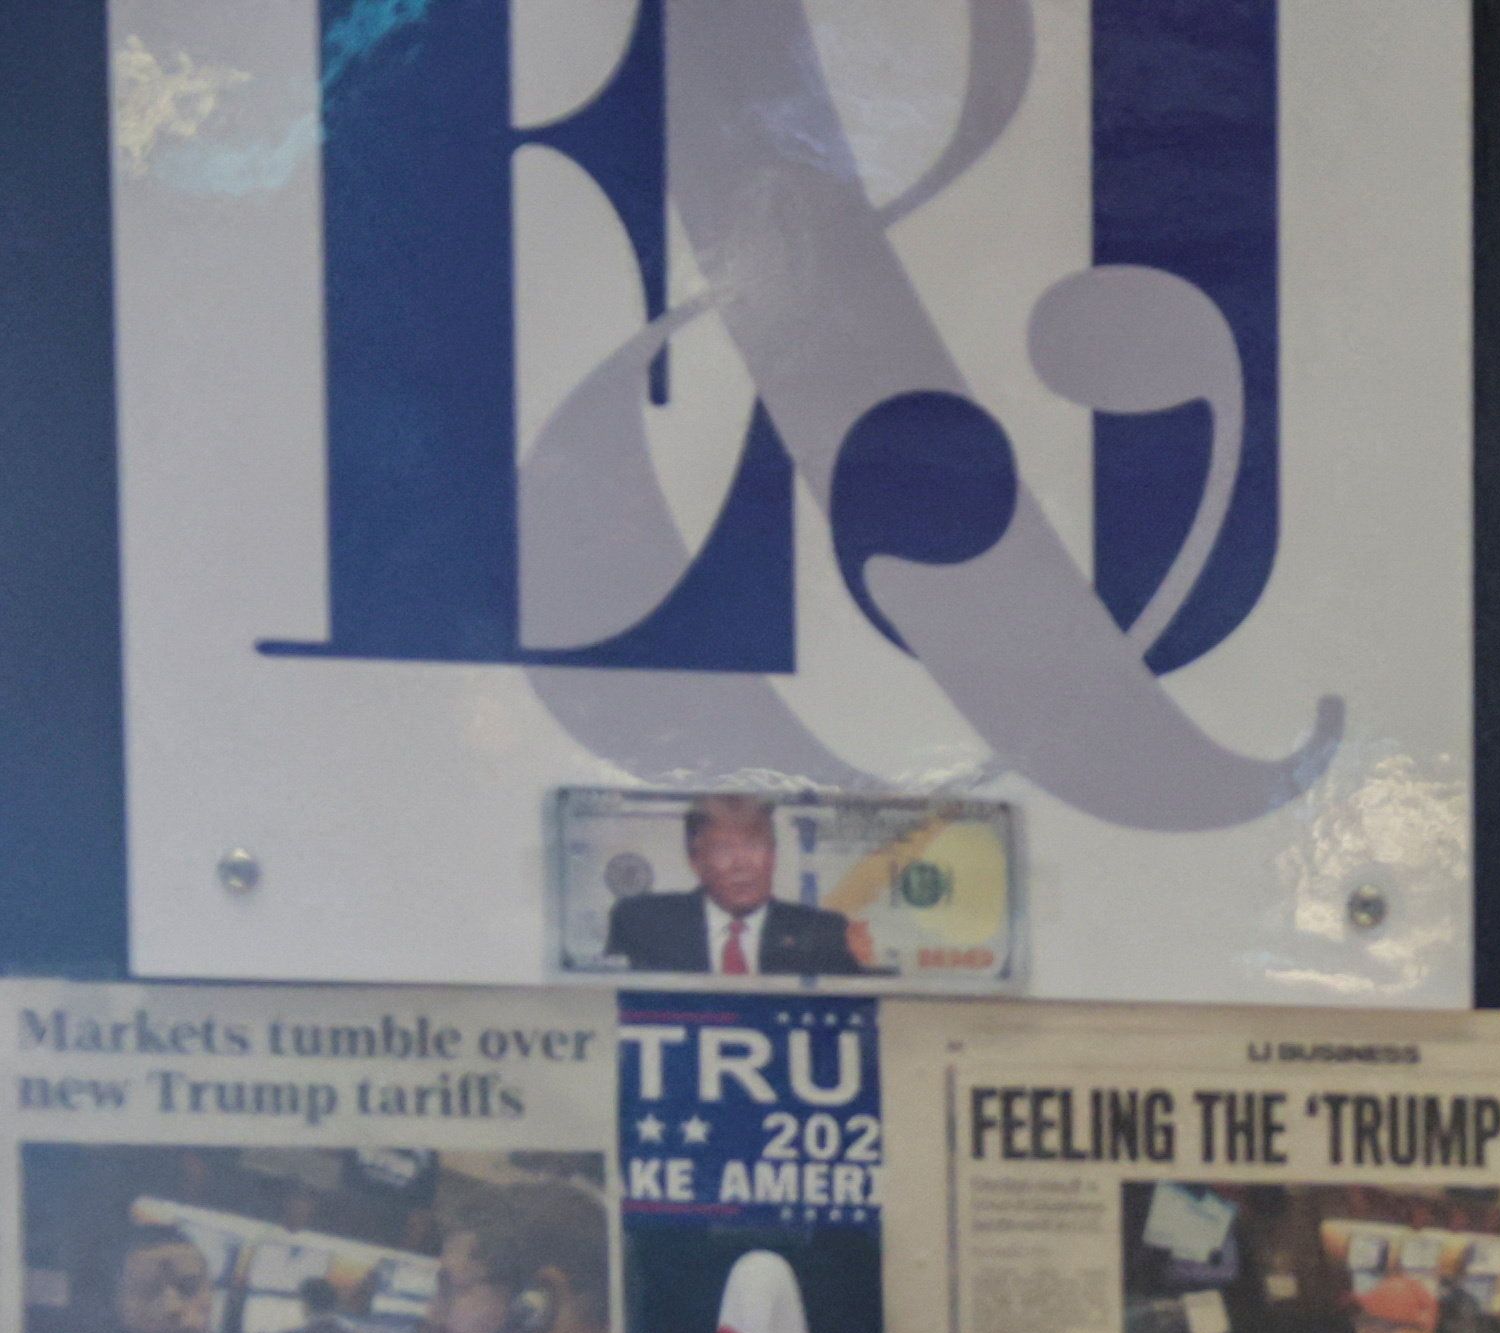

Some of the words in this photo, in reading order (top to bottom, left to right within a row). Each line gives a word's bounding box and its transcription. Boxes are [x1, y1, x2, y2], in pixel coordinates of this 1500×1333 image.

[20, 1008, 250, 1058] Markets
[271, 1012, 464, 1060] tumble
[480, 1025, 596, 1063] over
[1277, 1040, 1421, 1065] BUSINESS
[20, 1074, 131, 1112] new
[149, 1070, 338, 1122] Trump
[355, 1069, 527, 1119] tariffs
[968, 1088, 1177, 1162] FEELING
[1193, 1091, 1288, 1166] THE
